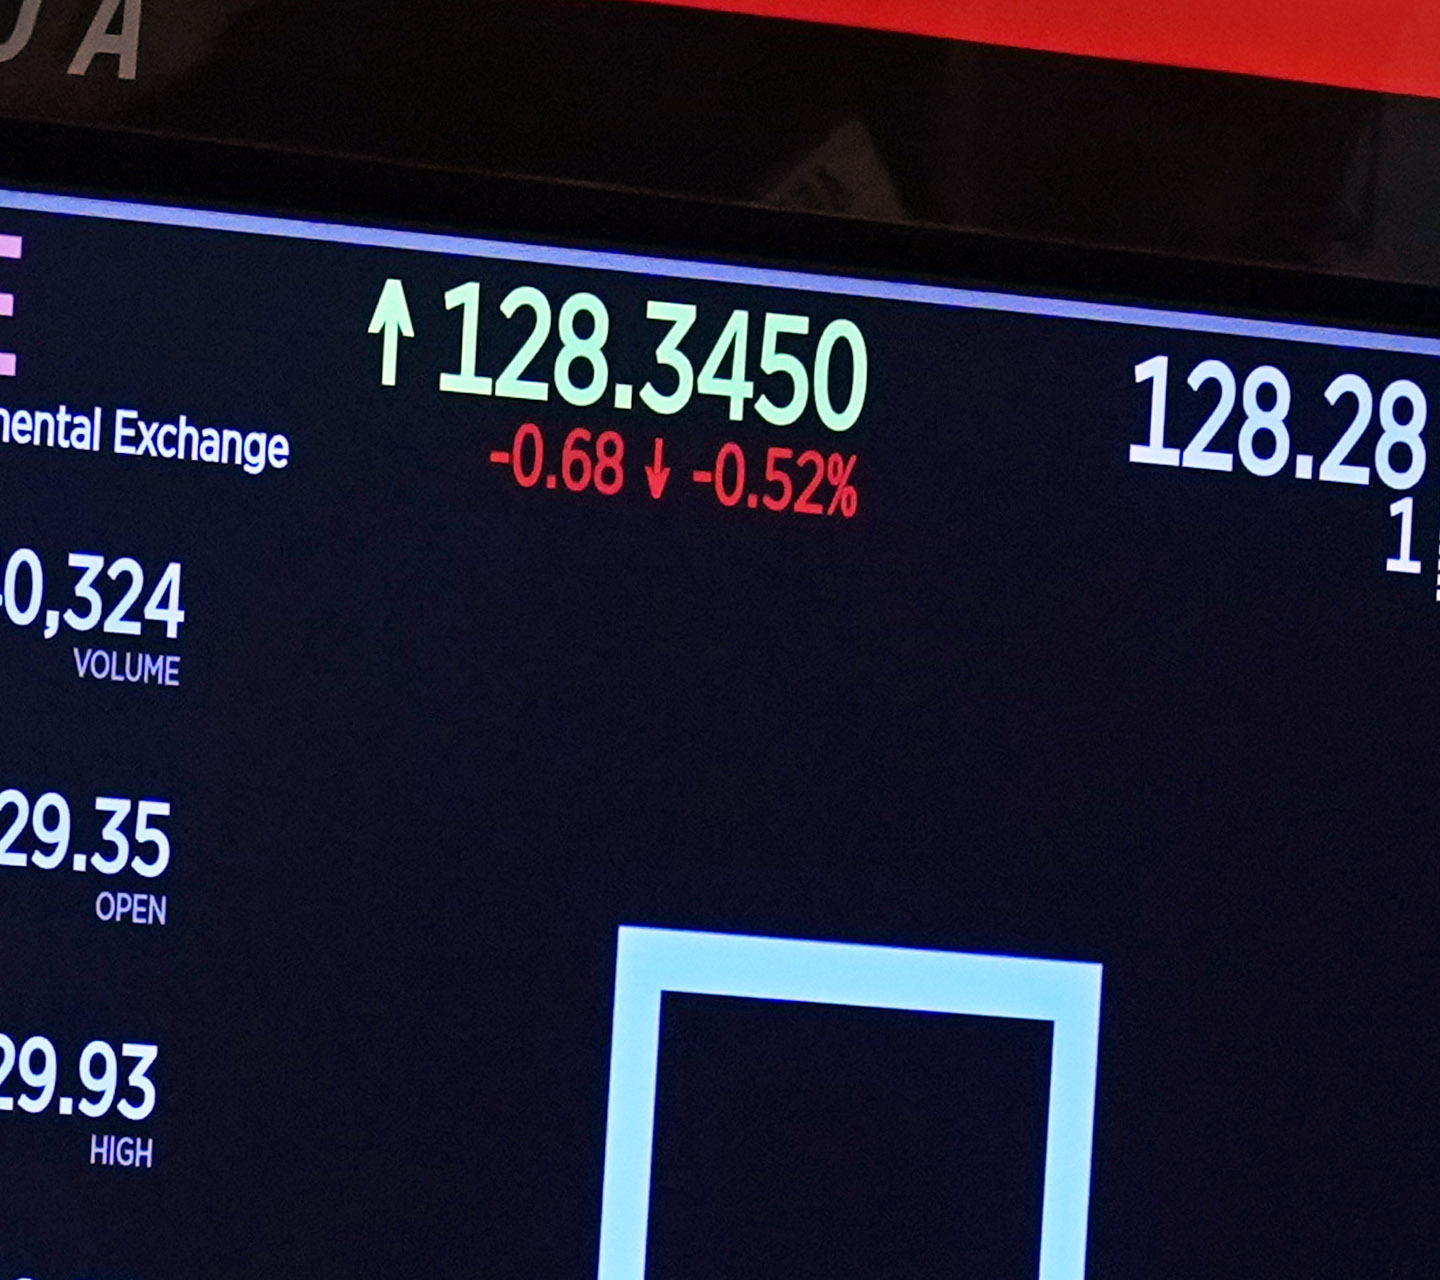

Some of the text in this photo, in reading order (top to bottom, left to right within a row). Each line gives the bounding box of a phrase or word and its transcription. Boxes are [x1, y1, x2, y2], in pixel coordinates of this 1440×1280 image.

[439, 281, 869, 432] 128.3450
[114, 408, 290, 475] Exchange
[1128, 353, 1429, 490] 128.28
[490, 422, 859, 519] -0.68 -0.52%
[1386, 496, 1422, 575] 1
[73, 646, 181, 687] VOLUME
[95, 891, 167, 925] OPEN
[89, 1133, 153, 1169] HIGH
